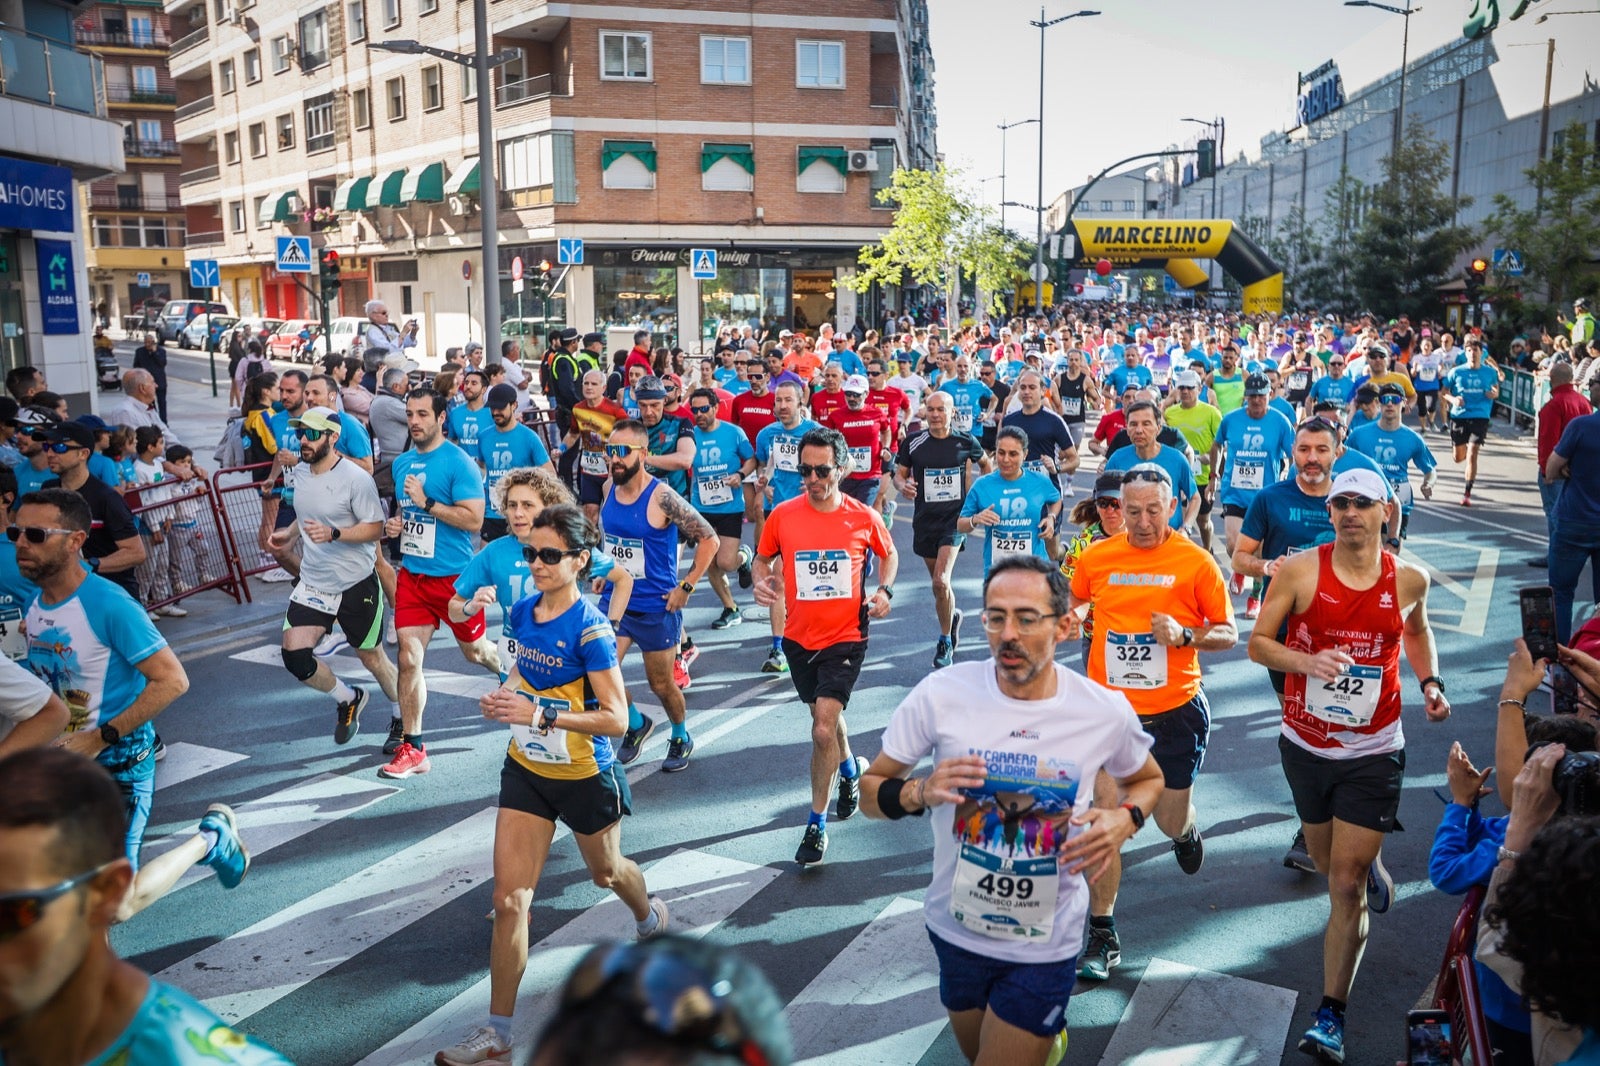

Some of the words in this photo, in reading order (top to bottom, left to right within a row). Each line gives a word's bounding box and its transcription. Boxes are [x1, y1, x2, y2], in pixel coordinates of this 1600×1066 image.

[1093, 226, 1211, 244] MARCELINO
[631, 248, 677, 262] Puerta
[47, 295, 75, 305] ALDABA
[742, 407, 771, 415] MARCELINO
[843, 419, 874, 428] MARCELINO
[1243, 433, 1265, 450] 18
[700, 447, 721, 465] 18
[780, 444, 797, 455] 639
[1236, 450, 1268, 458] MARCELINO
[492, 451, 513, 469] 18
[697, 463, 728, 473] MARCELINO
[1239, 467, 1256, 476] 853
[702, 480, 725, 491] 1051
[933, 476, 953, 486] 438
[1000, 496, 1028, 518] 18
[403, 521, 424, 535] 470
[997, 539, 1026, 551] 2275
[611, 546, 633, 559] 486
[808, 561, 838, 575] 964
[1336, 630, 1372, 640] GENERALI
[1116, 646, 1152, 661] 322
[984, 750, 1037, 767] CARRERA
[977, 873, 1034, 900] 499
[969, 890, 1012, 907] FRANCISCO
